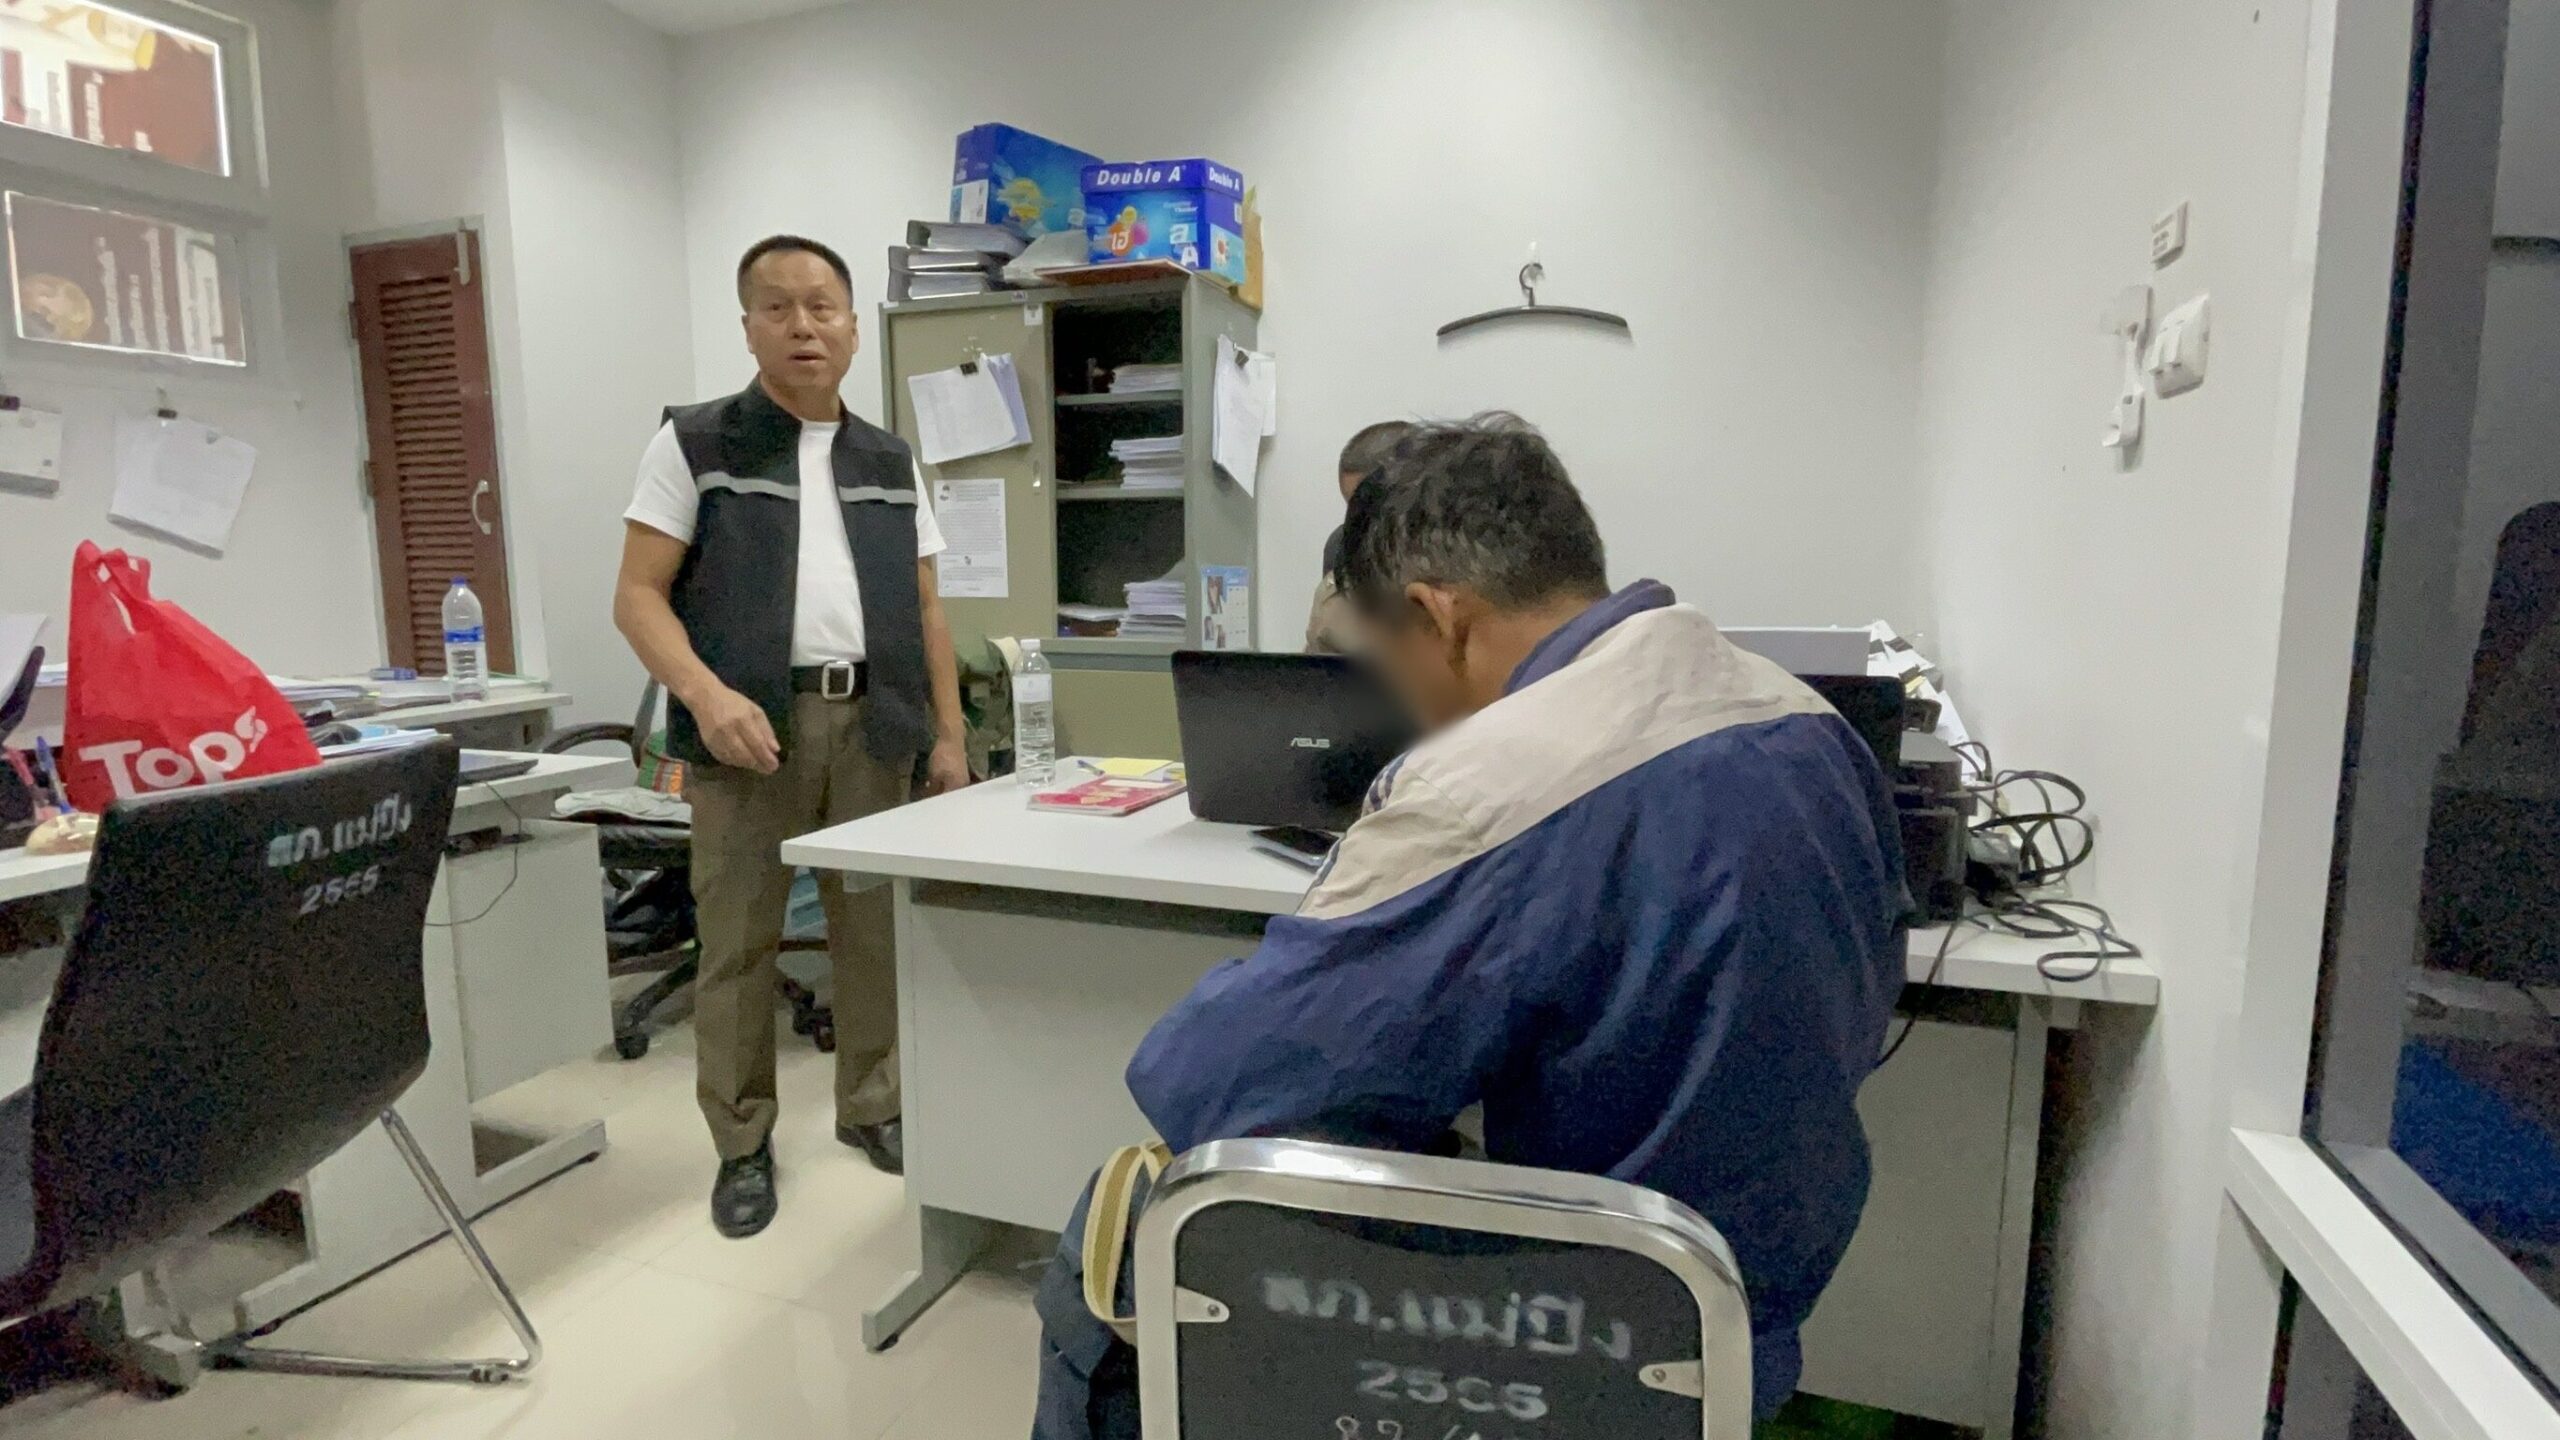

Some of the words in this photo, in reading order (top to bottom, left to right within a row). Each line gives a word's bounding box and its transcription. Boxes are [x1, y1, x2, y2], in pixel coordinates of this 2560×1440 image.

[1097, 167, 1162, 185] Double
[1168, 166, 1181, 182] A
[1209, 167, 1233, 188] Double
[1290, 737, 1330, 748] ASUS
